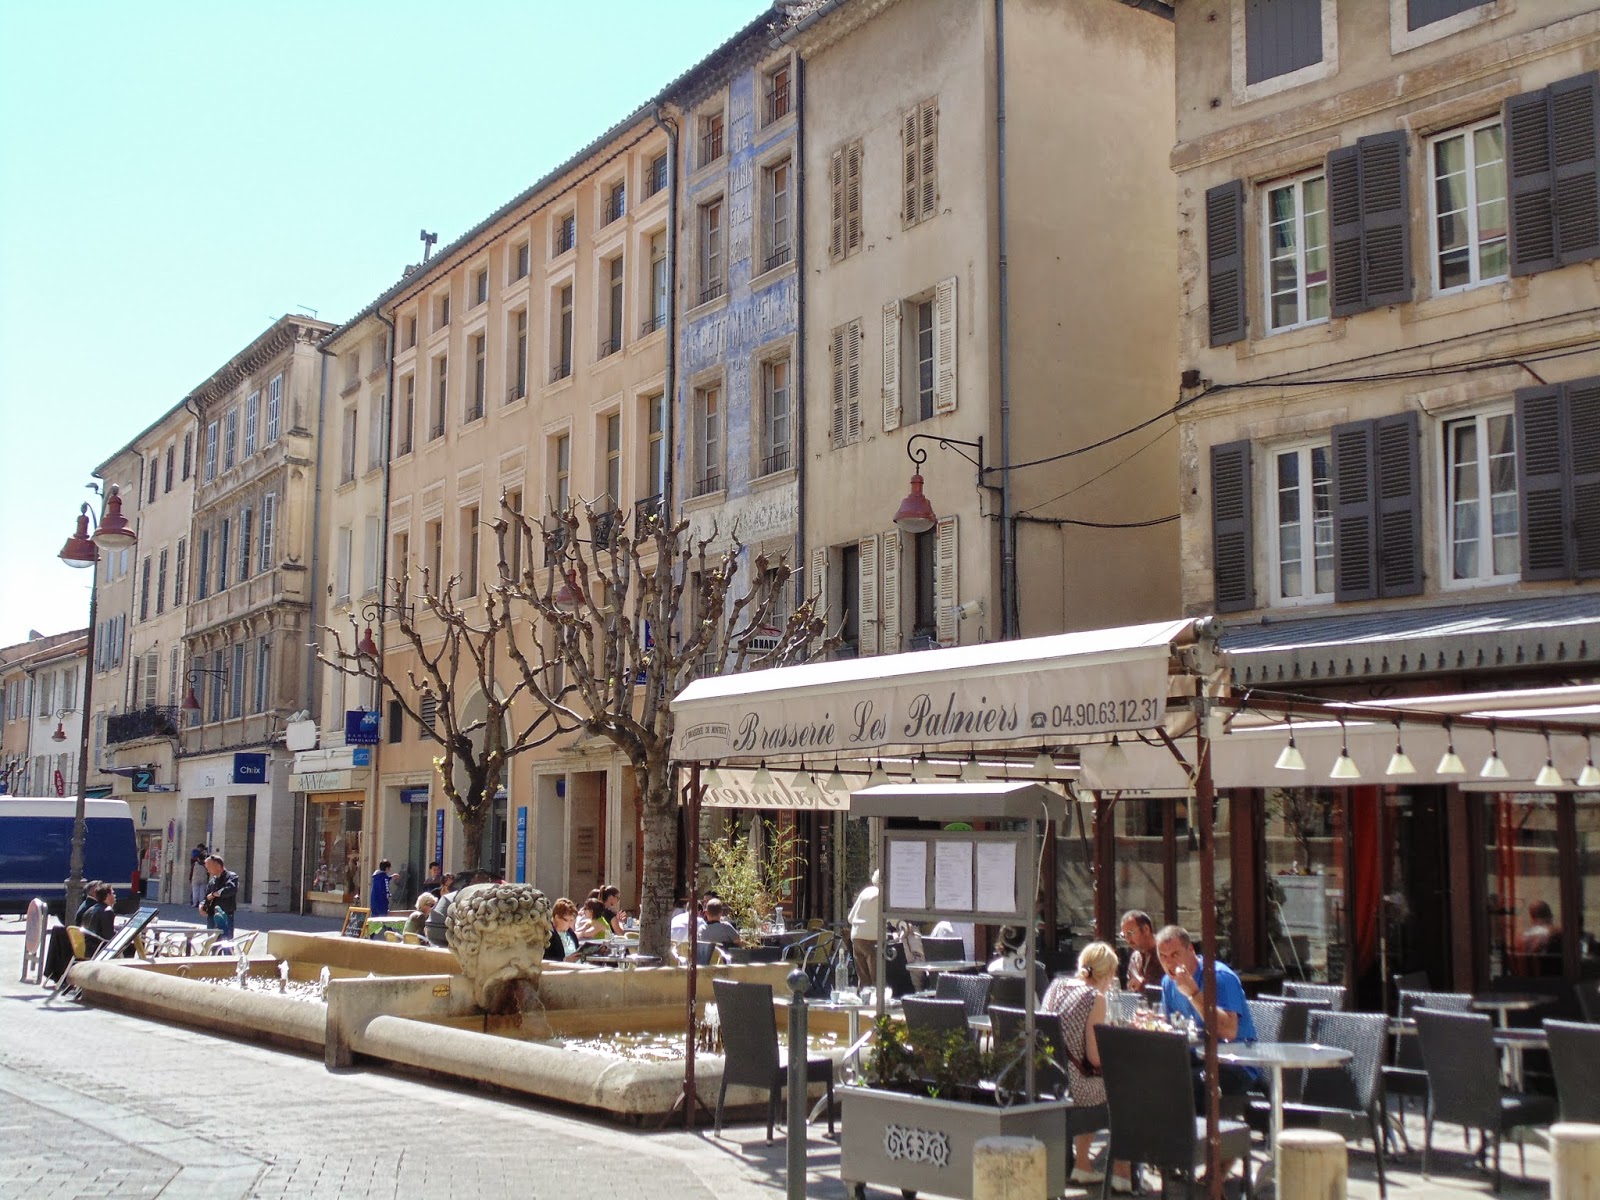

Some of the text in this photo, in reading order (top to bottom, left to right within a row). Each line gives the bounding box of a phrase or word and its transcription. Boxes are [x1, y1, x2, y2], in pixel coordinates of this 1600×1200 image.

[731, 159, 753, 196] PARIS
[701, 314, 731, 360] PETIT
[733, 692, 1159, 752] Brasserie Les Palmiers 04.90.63.12.31
[55, 772, 63, 795] TABAC
[137, 773, 150, 789] Z
